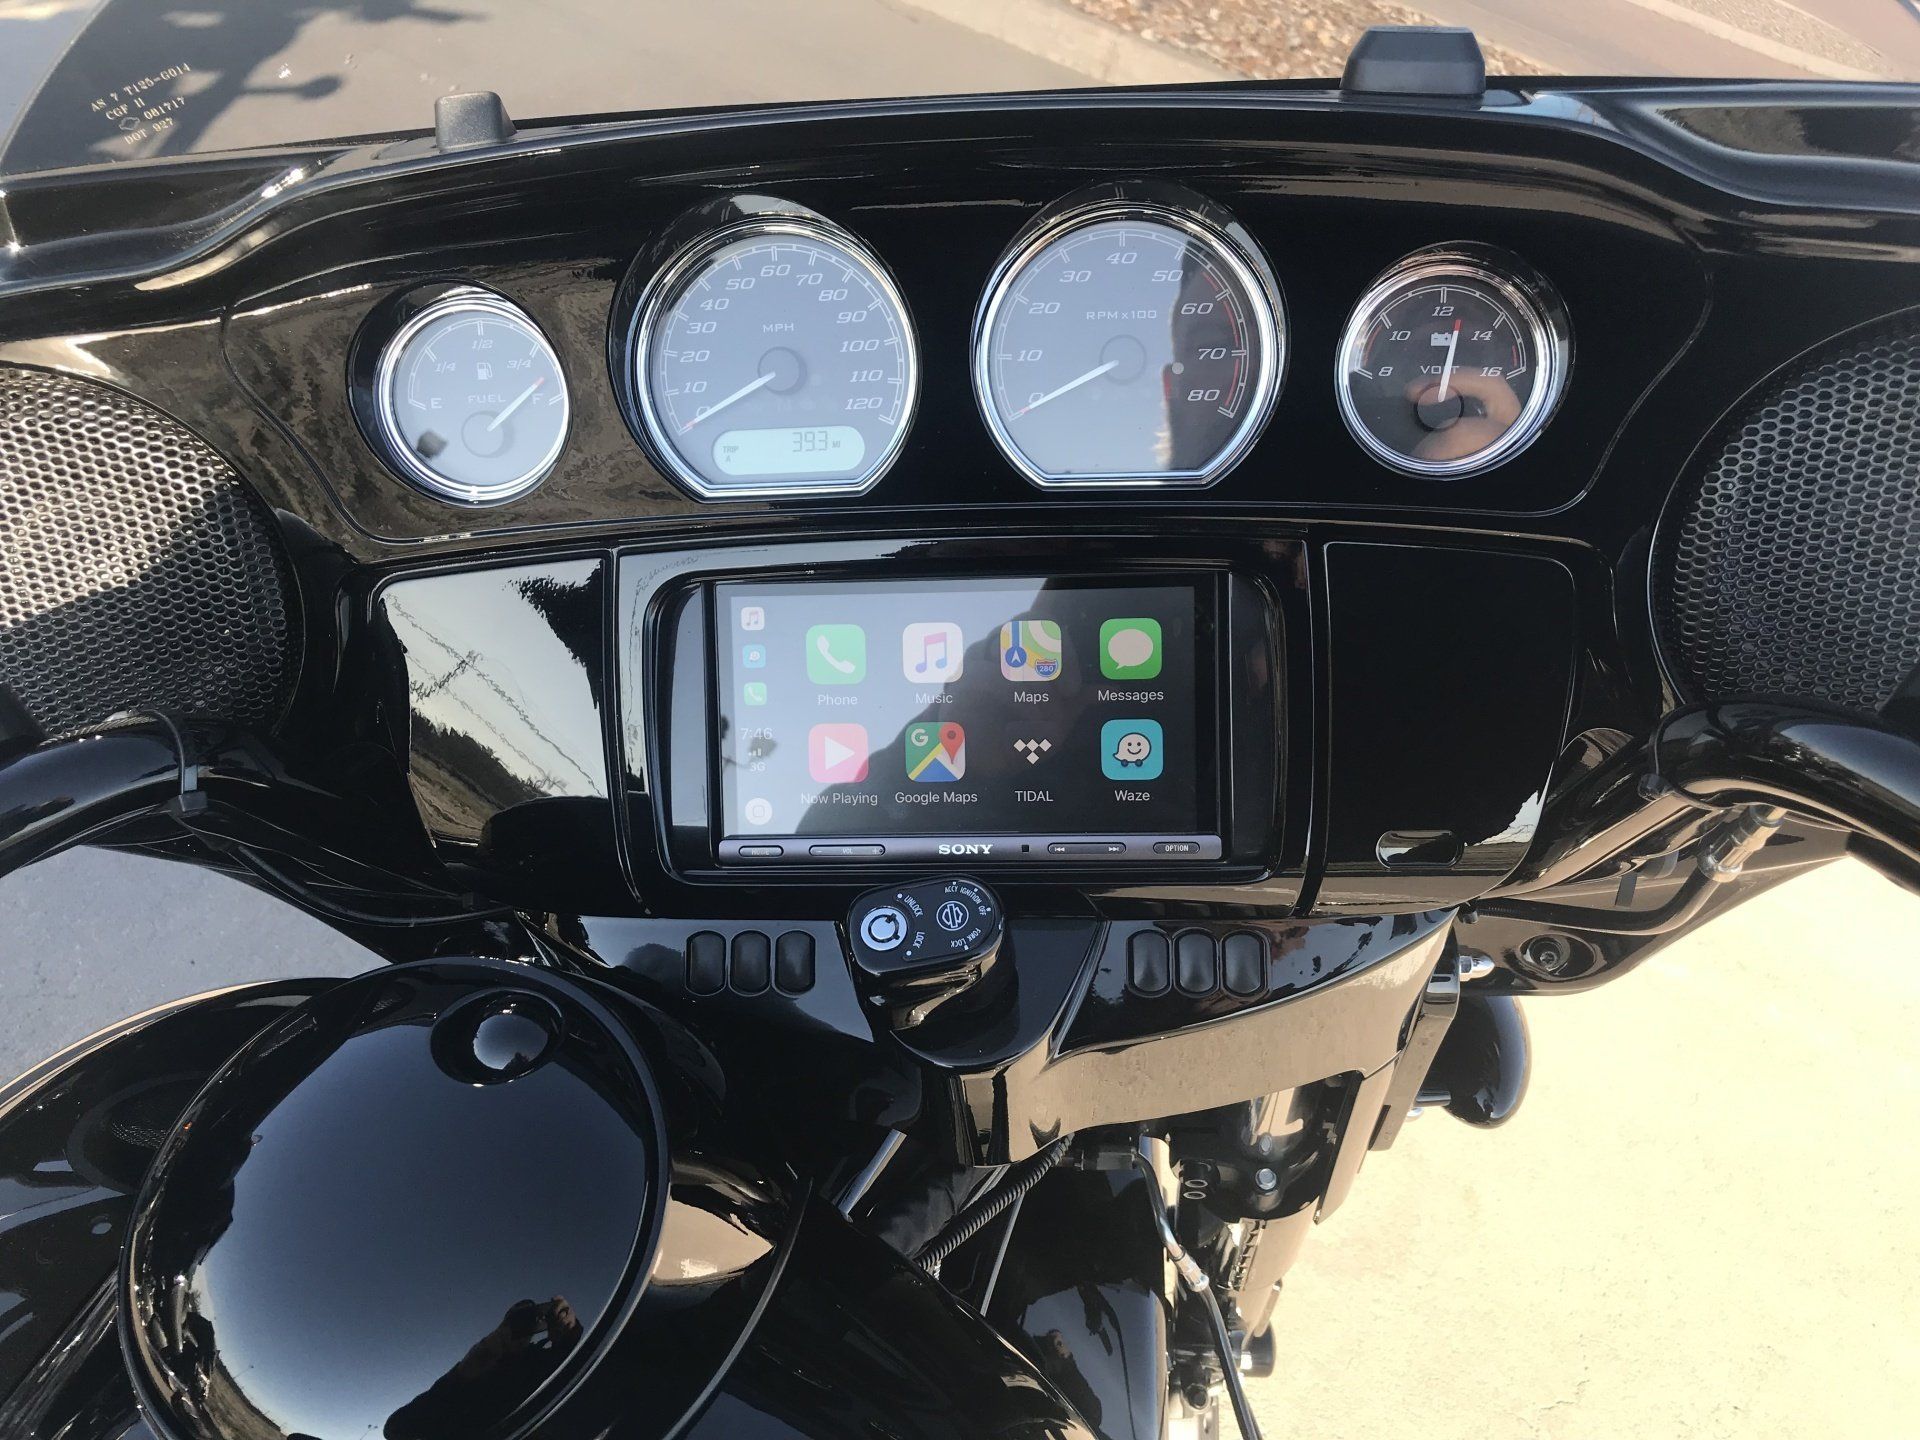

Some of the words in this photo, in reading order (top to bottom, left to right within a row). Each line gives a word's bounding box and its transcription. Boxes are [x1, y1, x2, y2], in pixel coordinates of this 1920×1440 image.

[123, 128, 148, 145] DOT
[152, 117, 174, 132] 927
[1104, 252, 1138, 264] 40
[760, 264, 791, 277] 60
[1059, 270, 1092, 282] 30
[1151, 269, 1184, 282] 50
[725, 277, 756, 290] 50
[795, 273, 823, 286] 70
[818, 289, 848, 302] 80
[700, 298, 730, 311] 40
[1028, 302, 1061, 314] 20
[1180, 302, 1214, 315] 60
[836, 310, 867, 323] 90
[1431, 306, 1455, 317] 12
[686, 321, 717, 334] 30
[762, 322, 795, 334] MPH
[1389, 330, 1411, 341] 10
[1470, 330, 1493, 341] 14
[471, 338, 494, 351] 1/2
[839, 339, 880, 352] 100
[680, 350, 710, 363] 20
[1016, 350, 1043, 362] 10
[1198, 347, 1227, 360] 70
[434, 361, 456, 375] 1/4
[506, 358, 532, 372] 3/4
[1378, 366, 1393, 377] 8
[1420, 365, 1460, 375] VOT
[1479, 366, 1503, 377] 16
[850, 369, 883, 382] 110
[683, 381, 707, 394] 10
[467, 394, 507, 404] FUEL
[1187, 389, 1220, 402] 80
[430, 397, 443, 409] E
[844, 397, 883, 411] 120
[817, 693, 858, 706] Phone
[915, 692, 953, 705] Music
[1013, 690, 1050, 706] Maps
[1097, 689, 1164, 704] Messages
[740, 727, 773, 741] 7:46
[800, 792, 831, 805] Now
[833, 791, 878, 807] Playing
[894, 791, 941, 806] Google
[943, 791, 978, 805] Maps
[1014, 790, 1054, 802] TIDAL
[1114, 789, 1150, 802] Waze
[938, 844, 993, 855] SONY
[1164, 843, 1189, 853] OPTION
[960, 886, 982, 905] IGNITION
[904, 895, 924, 917] UNLOCK
[978, 905, 987, 916] OFF
[913, 931, 925, 948] LOCK
[966, 927, 982, 942] FORK
[950, 937, 967, 948] LOCK
